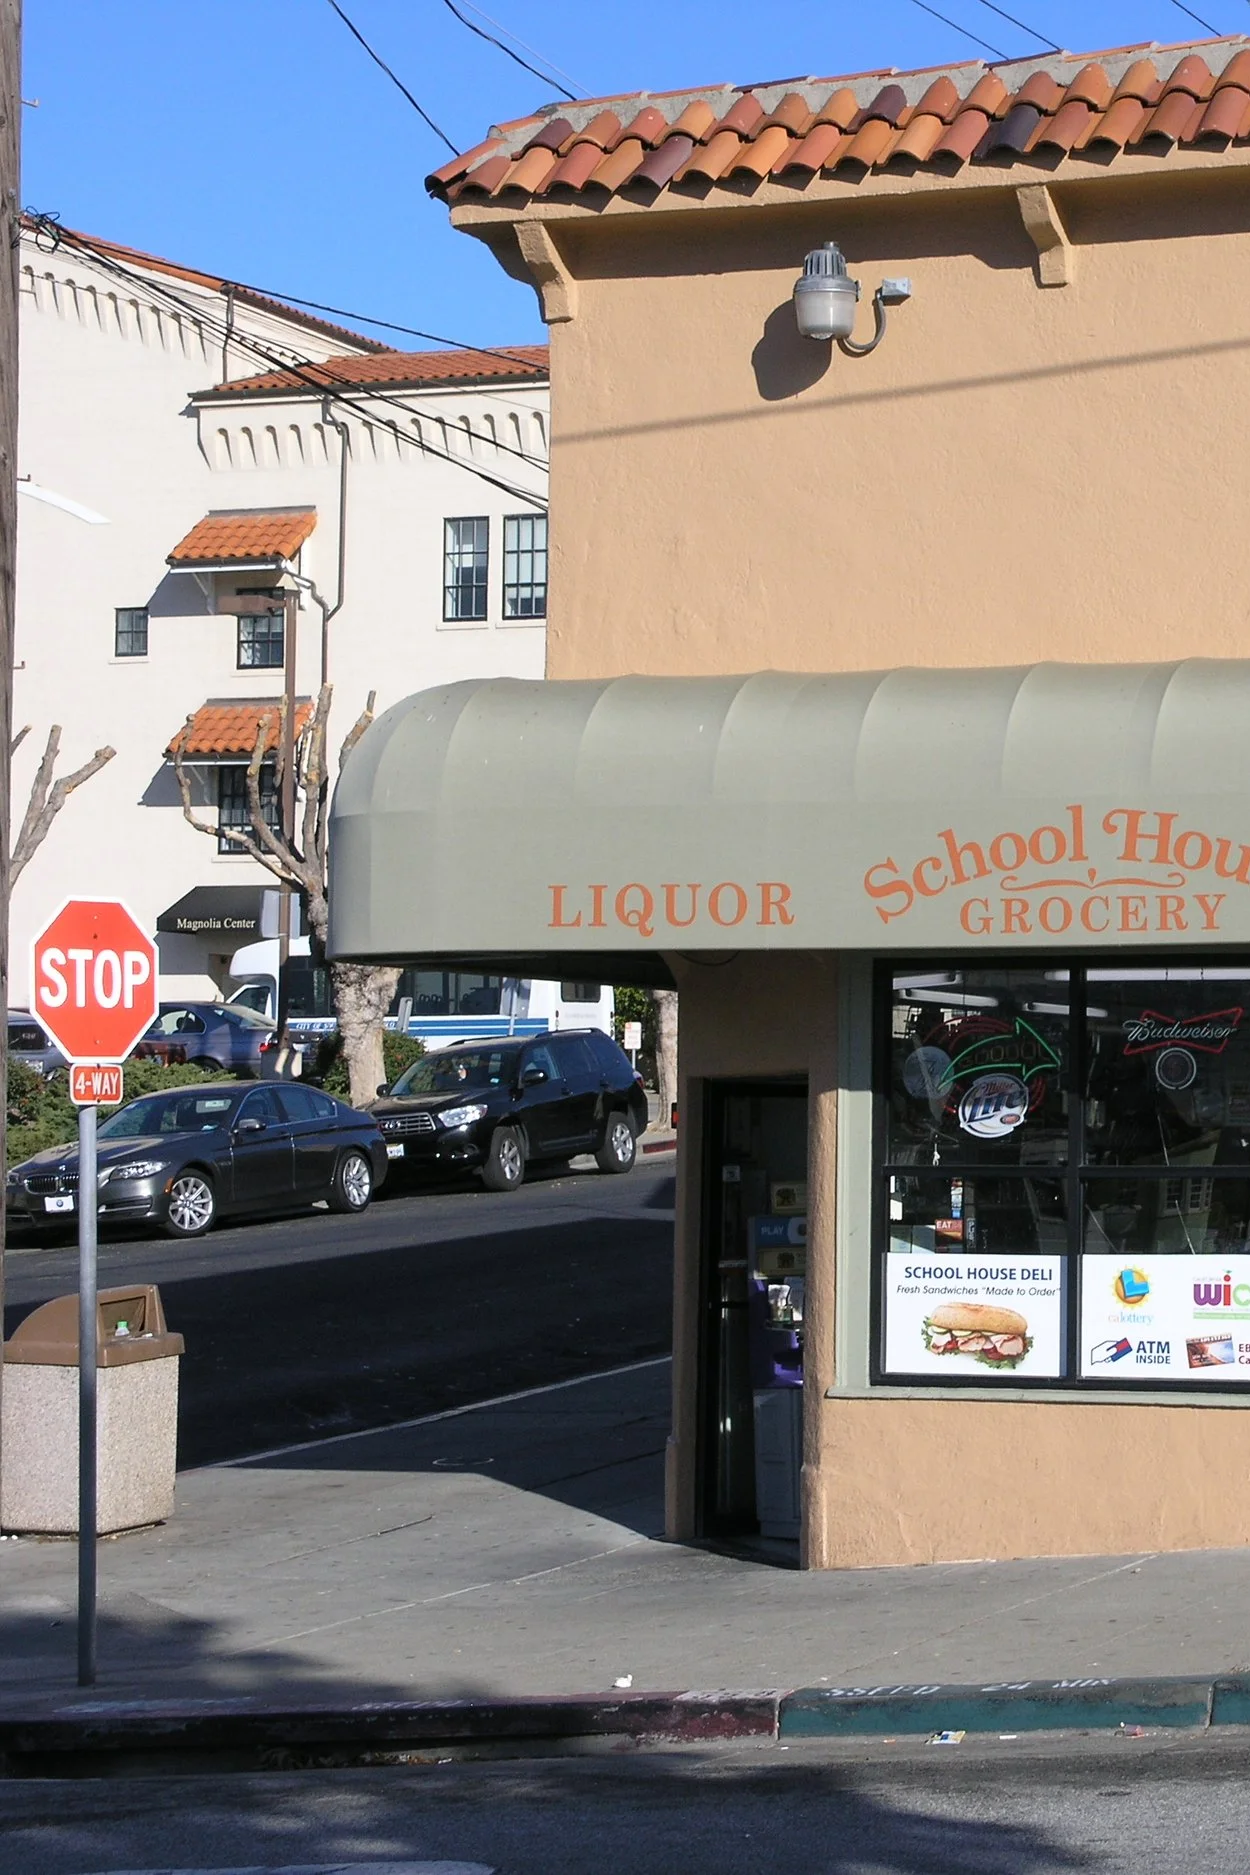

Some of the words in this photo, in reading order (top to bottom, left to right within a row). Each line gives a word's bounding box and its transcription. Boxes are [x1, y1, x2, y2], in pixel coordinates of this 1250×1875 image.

[864, 804, 1089, 925] School
[547, 881, 796, 937] LIQUOR
[959, 893, 1227, 936] GROCERY
[176, 917, 222, 931] Magnolia
[223, 917, 256, 929] Center
[39, 947, 150, 1009] STOP
[1122, 1017, 1238, 1041] Budweiser
[75, 1072, 119, 1096] 4-WAY
[761, 1226, 784, 1236] PLAY
[936, 1221, 952, 1229] EAT
[904, 1266, 963, 1280] SCHOOL
[967, 1267, 1017, 1281] HOUSE
[1021, 1269, 1052, 1281] DELI
[897, 1285, 921, 1294] Fresh
[923, 1286, 979, 1295] Sandwiches
[1016, 1287, 1026, 1296] to
[1108, 1312, 1154, 1325] calottery
[1136, 1340, 1171, 1355] ATM
[1136, 1355, 1171, 1365] INSIDE
